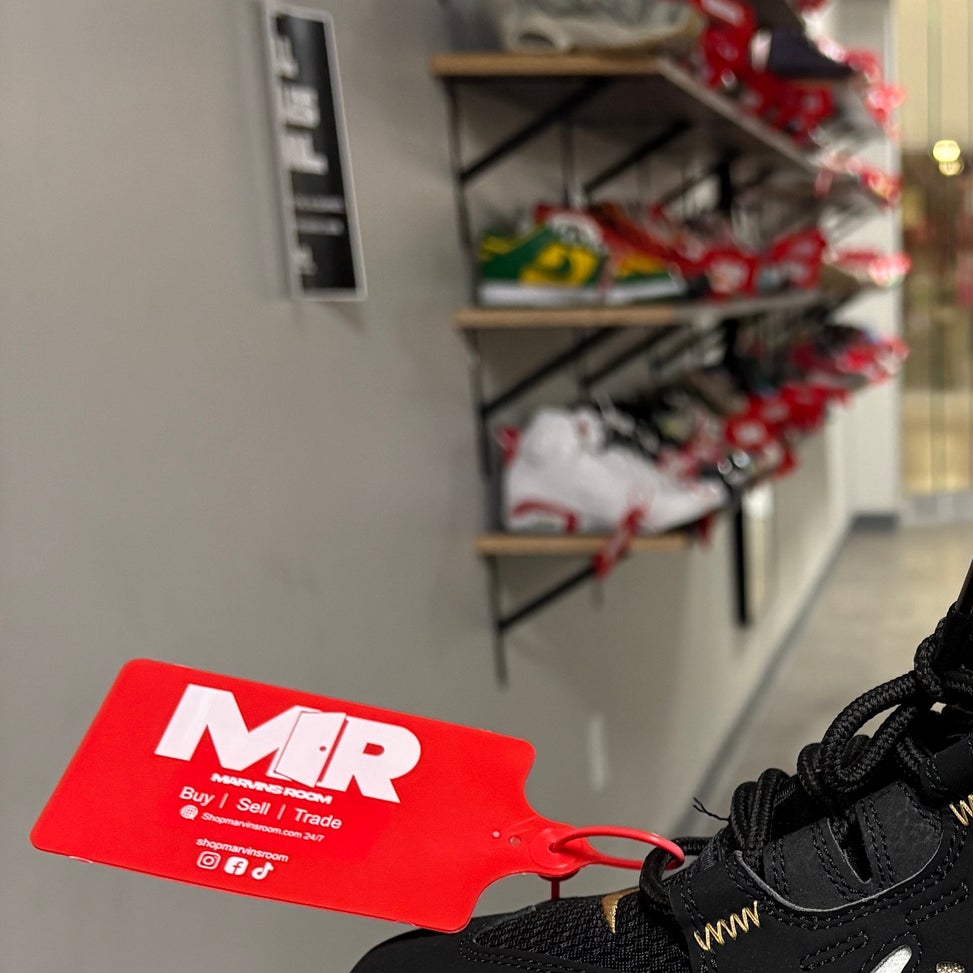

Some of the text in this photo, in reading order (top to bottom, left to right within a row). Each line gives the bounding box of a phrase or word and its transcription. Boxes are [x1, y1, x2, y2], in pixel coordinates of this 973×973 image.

[211, 773, 333, 804] MARVINS ROOM
[179, 786, 215, 806] Buy
[236, 797, 271, 815] Sell
[295, 808, 342, 830] Trade
[201, 812, 325, 842] Shopmarvinsroom.com 24/7
[196, 838, 288, 862] shopmarvinsroom
